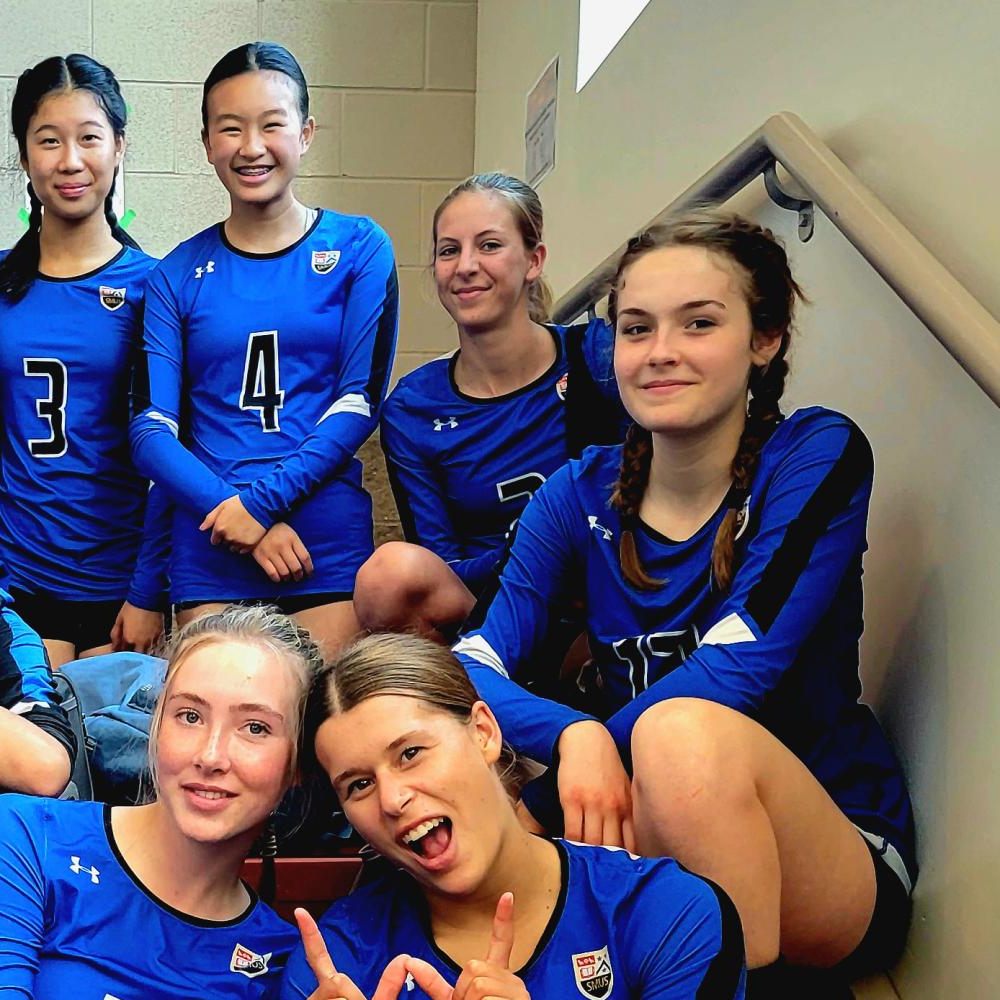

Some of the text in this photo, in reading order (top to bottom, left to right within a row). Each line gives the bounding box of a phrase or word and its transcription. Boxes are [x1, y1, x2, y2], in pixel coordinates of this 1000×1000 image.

[23, 358, 68, 458] 3
[239, 330, 285, 433] 4
[586, 975, 609, 992] SMUS
